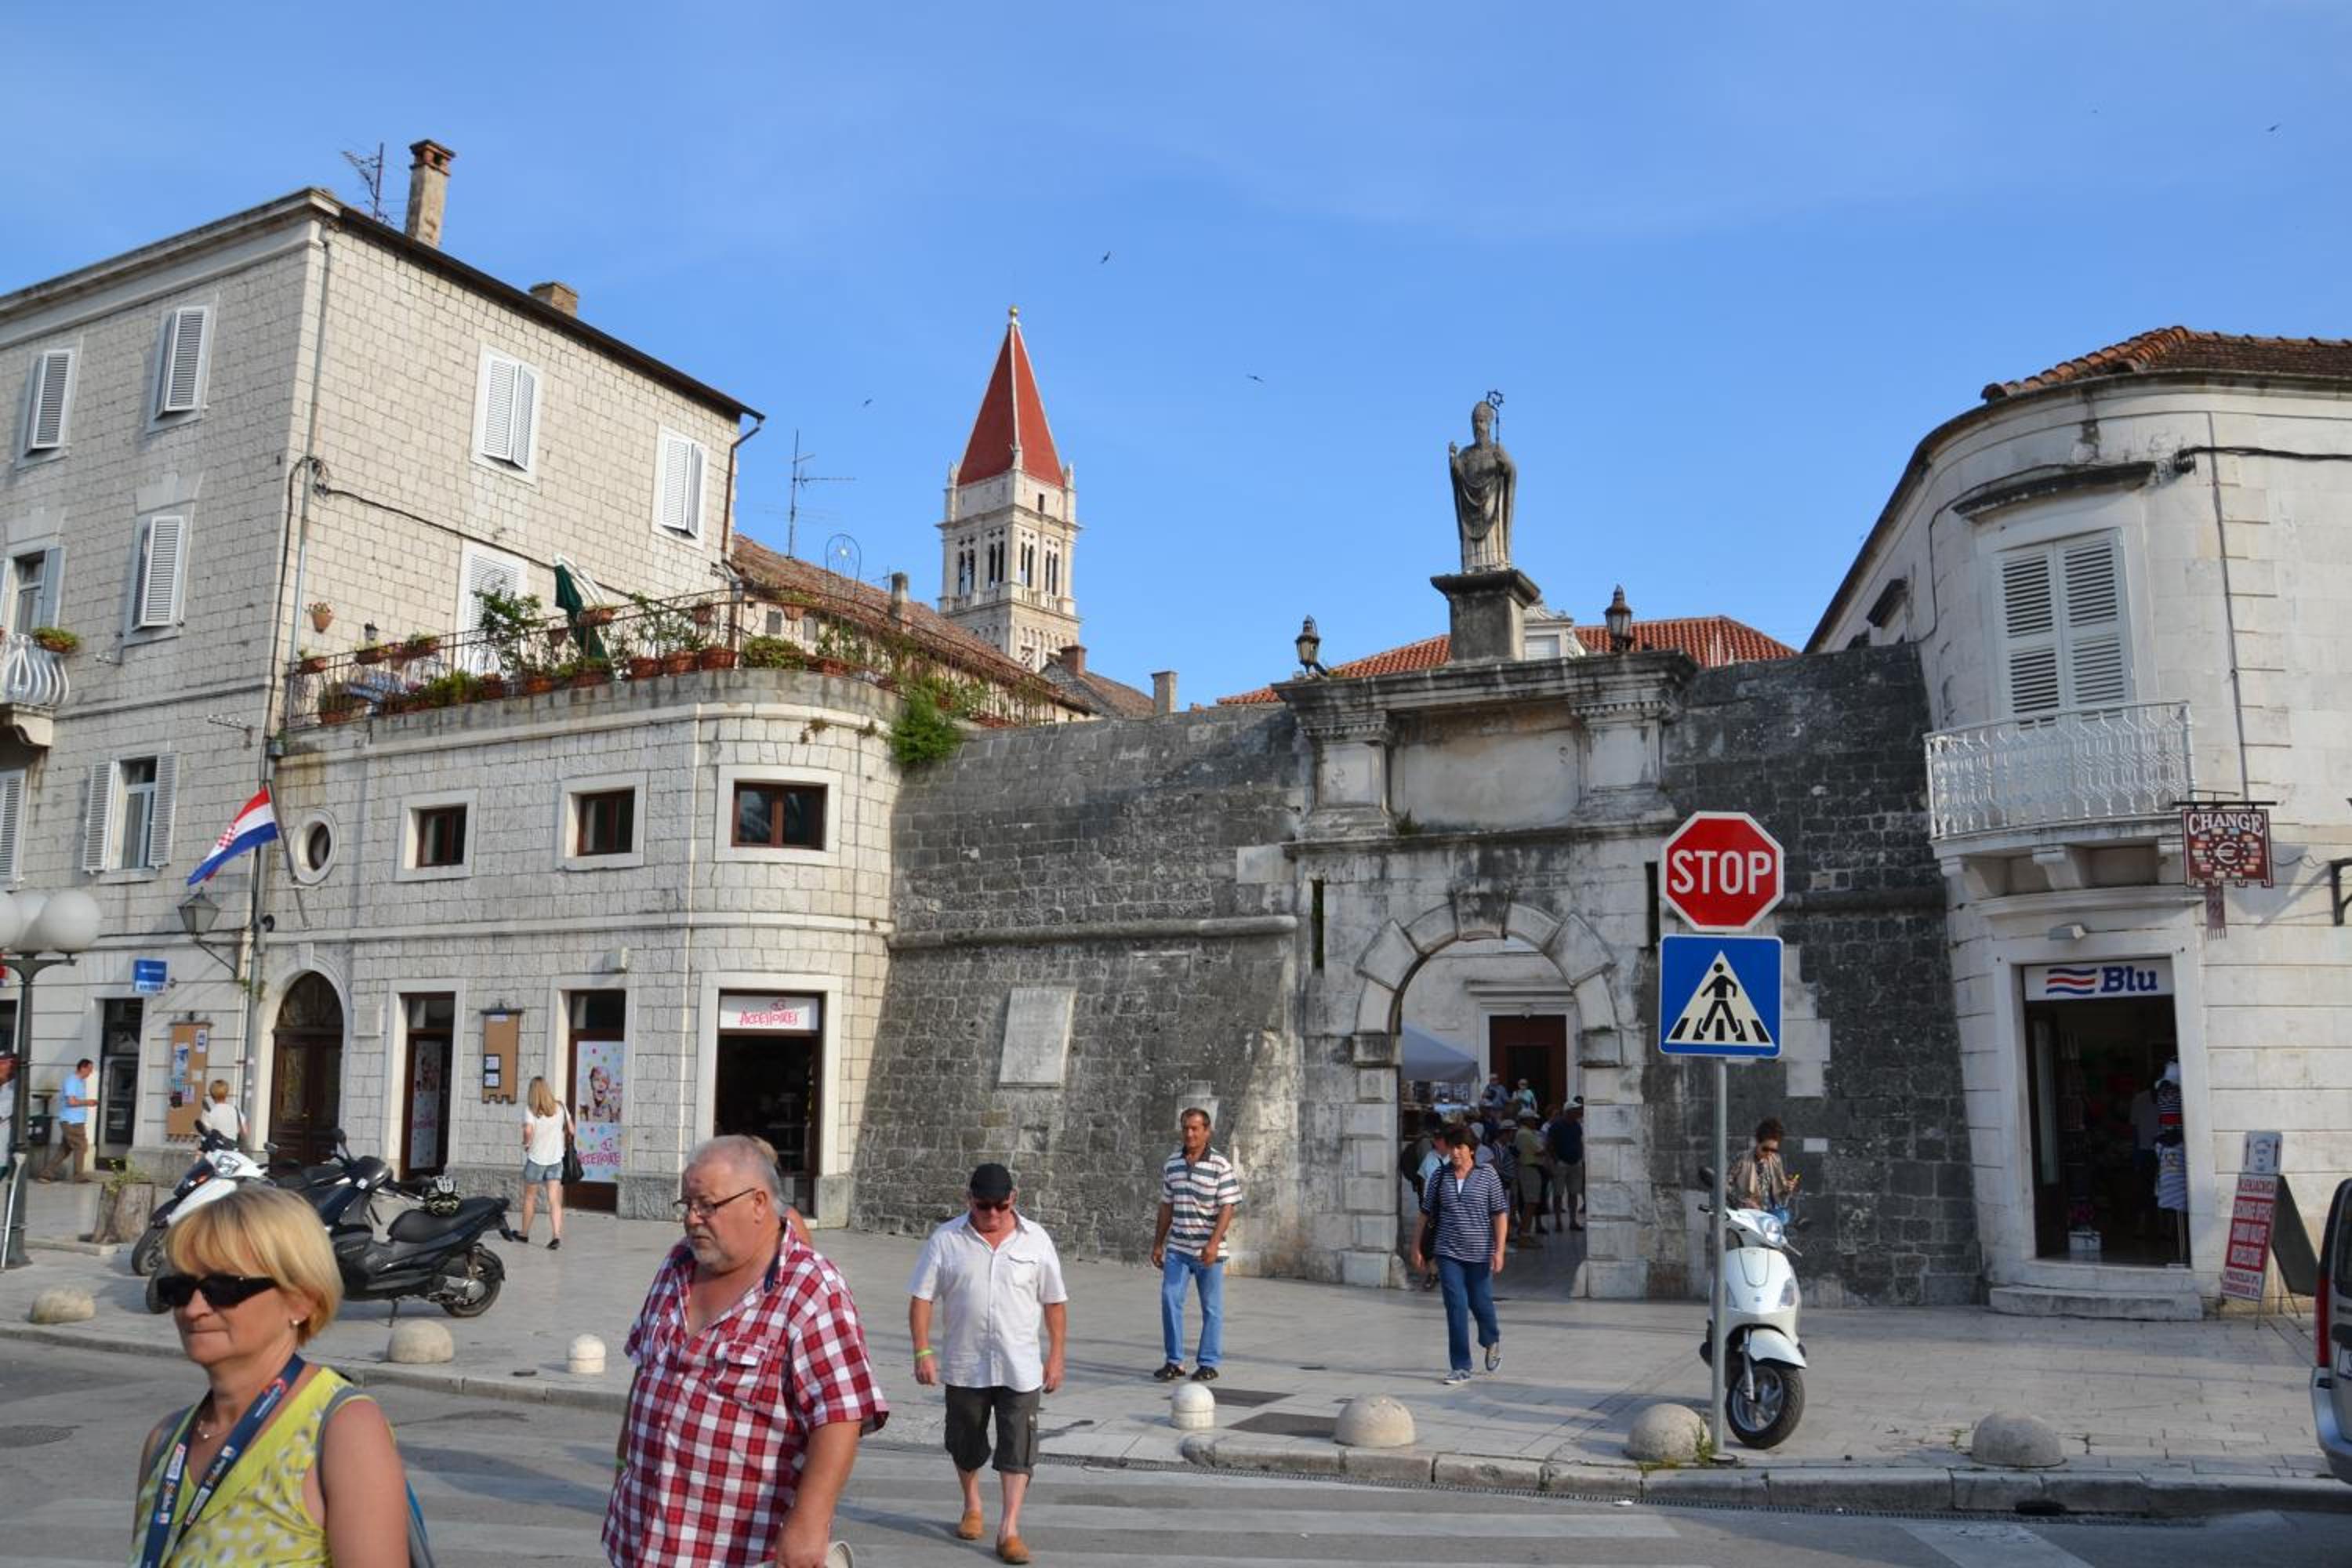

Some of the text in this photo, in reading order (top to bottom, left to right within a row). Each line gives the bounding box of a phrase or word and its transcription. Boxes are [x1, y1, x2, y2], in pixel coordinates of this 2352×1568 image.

[2187, 812, 2264, 837] CHANGE
[1671, 849, 1772, 895] STOP
[2100, 965, 2158, 993] Blu
